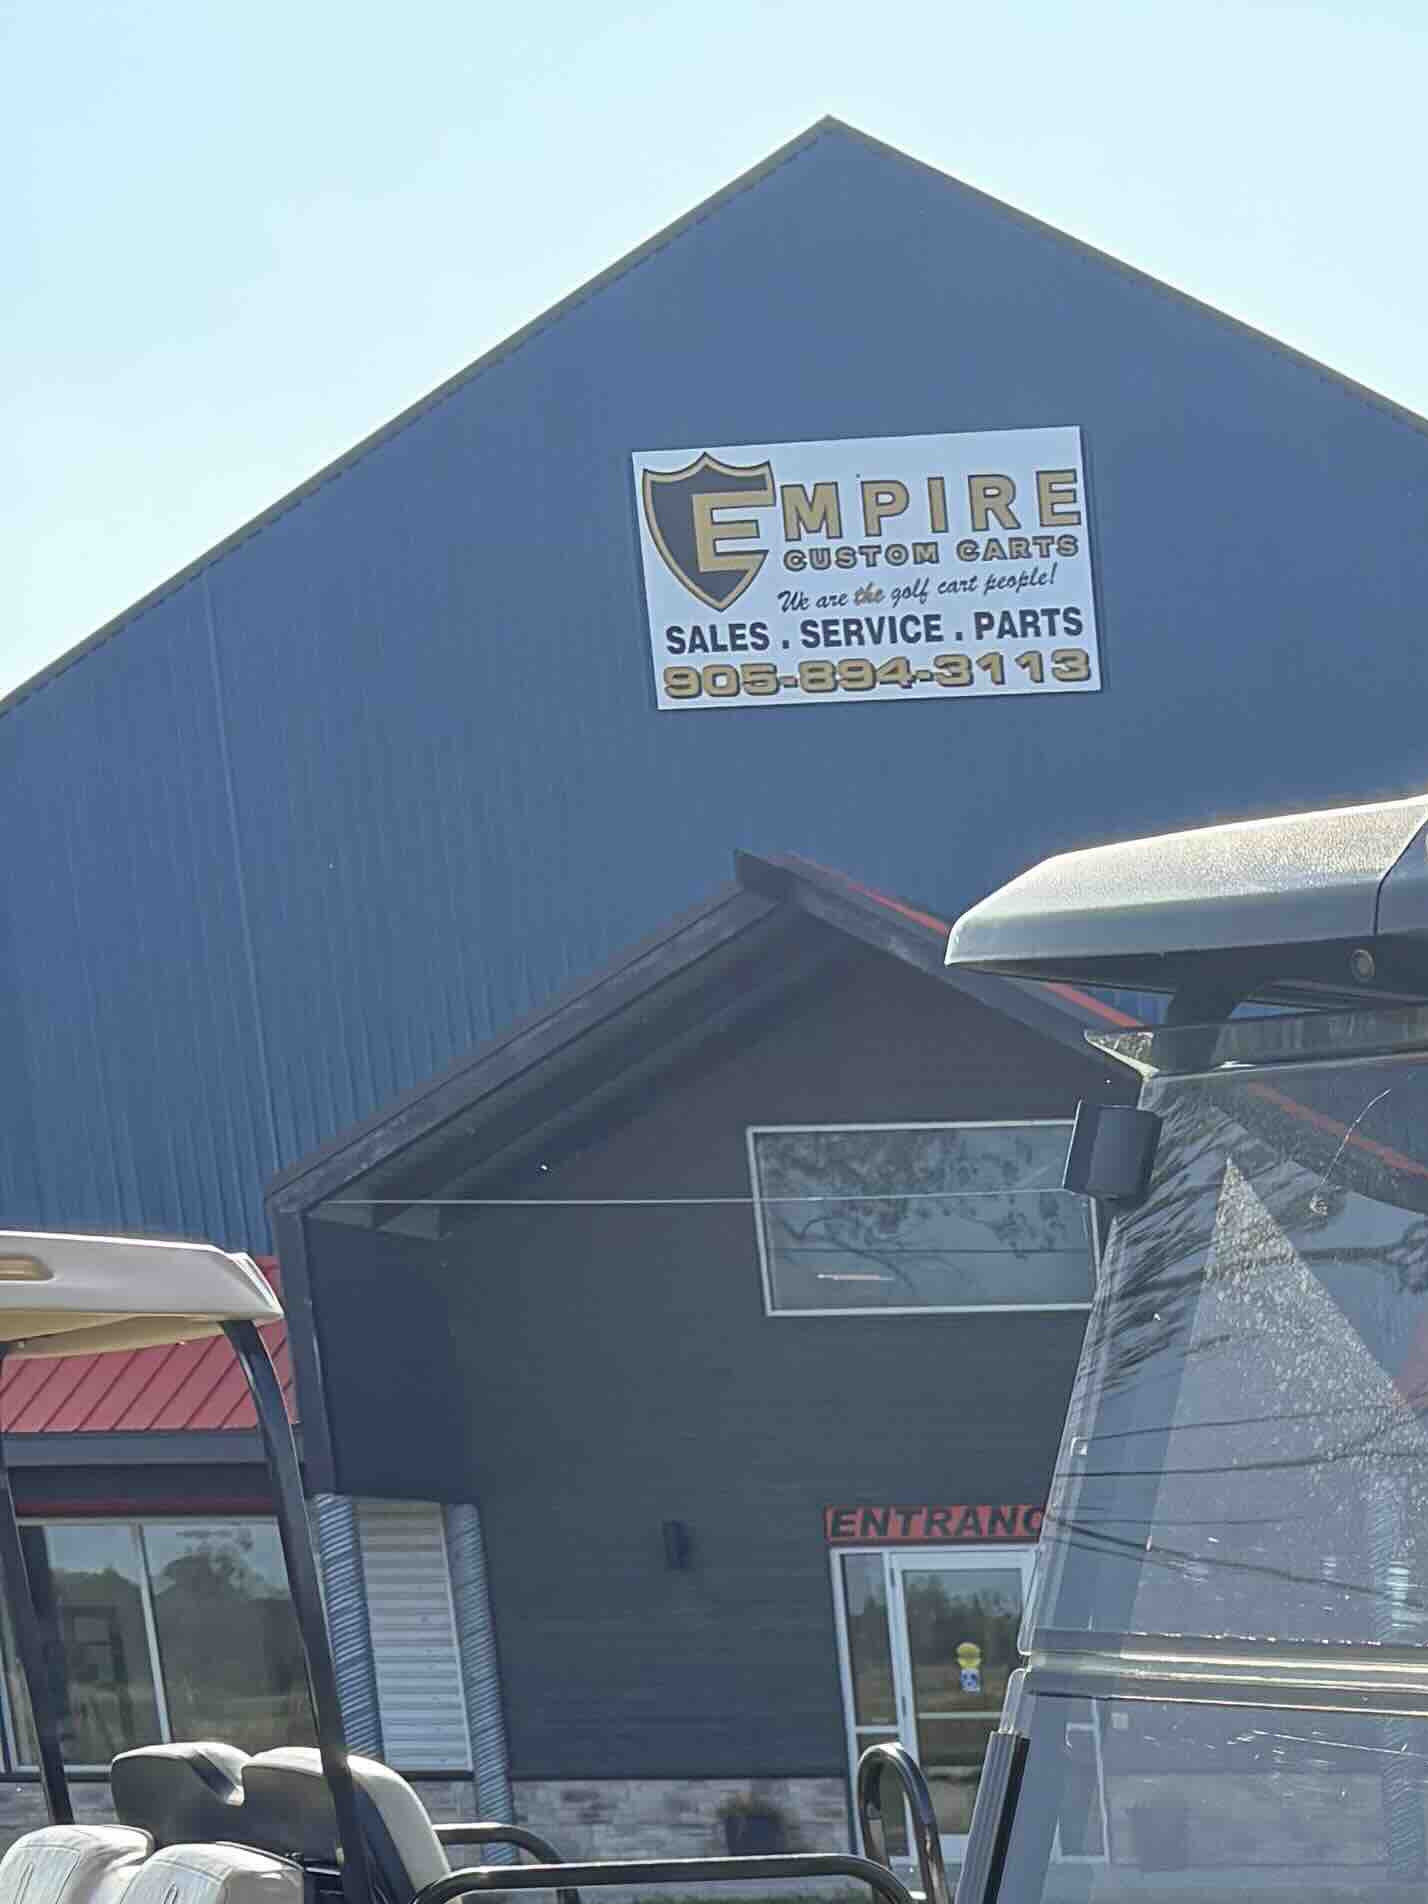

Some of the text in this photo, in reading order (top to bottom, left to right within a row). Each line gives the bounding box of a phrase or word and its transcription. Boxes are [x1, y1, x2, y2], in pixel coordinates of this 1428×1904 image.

[692, 468, 1083, 573] EMPIRE
[784, 534, 1078, 572] CUSTOM CARTS
[777, 561, 1058, 612] We are the golf cart people!
[666, 622, 770, 654] SALES
[800, 613, 943, 648] SERVICE
[974, 607, 1083, 640] PARTS
[663, 648, 1092, 698] 905-894-3113
[830, 1505, 1041, 1537] ENTRANC
